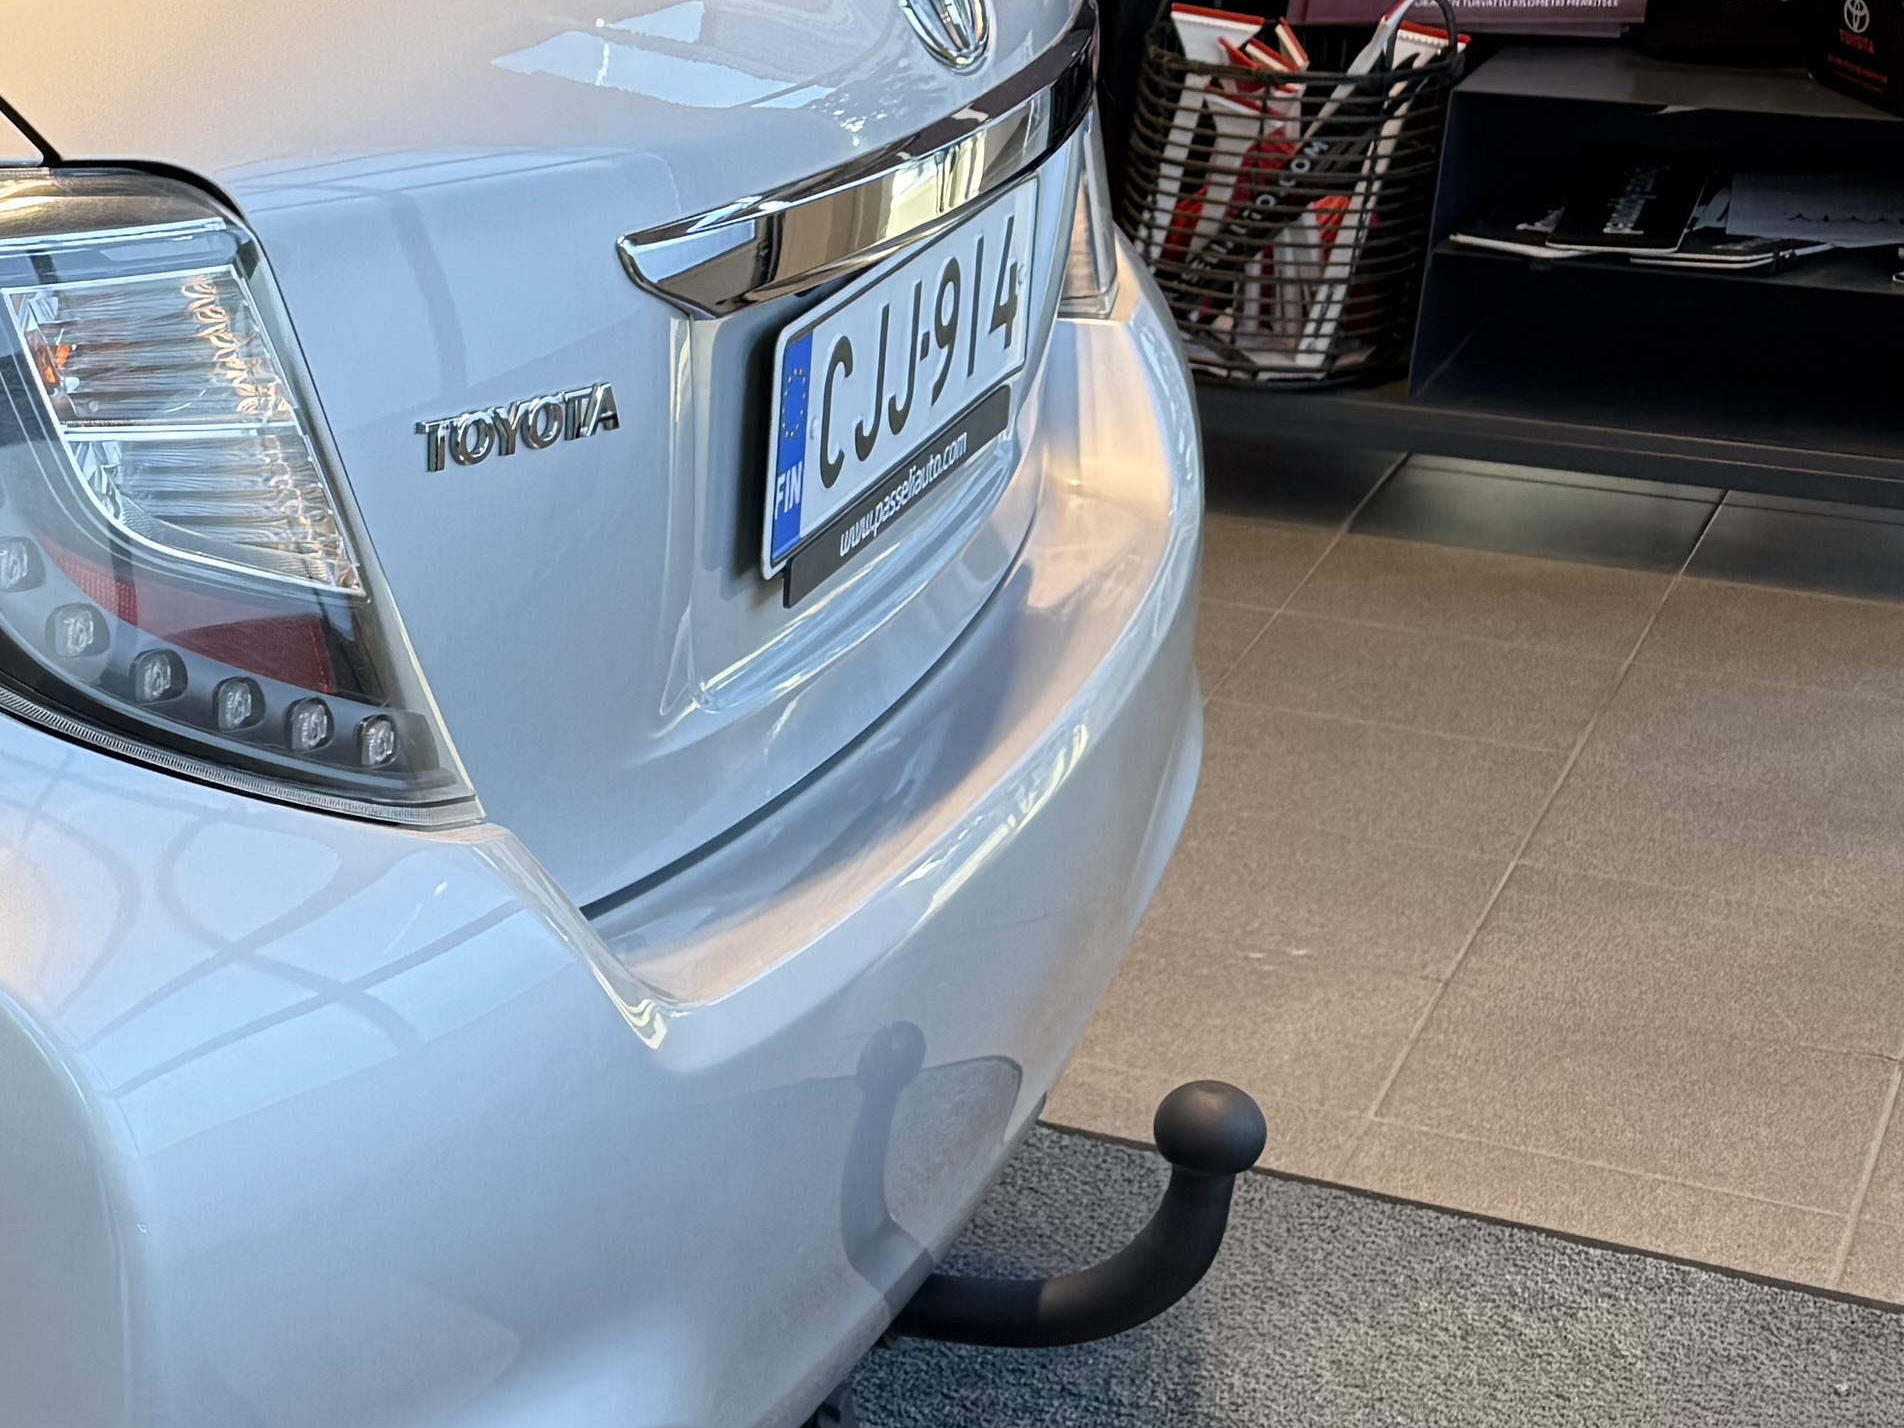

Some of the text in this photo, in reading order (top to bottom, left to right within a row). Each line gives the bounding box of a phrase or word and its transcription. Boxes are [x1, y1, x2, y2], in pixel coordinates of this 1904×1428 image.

[819, 214, 1019, 489] CJJ-914
[414, 381, 620, 473] TOYOTA
[773, 461, 804, 521] FIN
[839, 431, 969, 558] www.passeliauto.com
